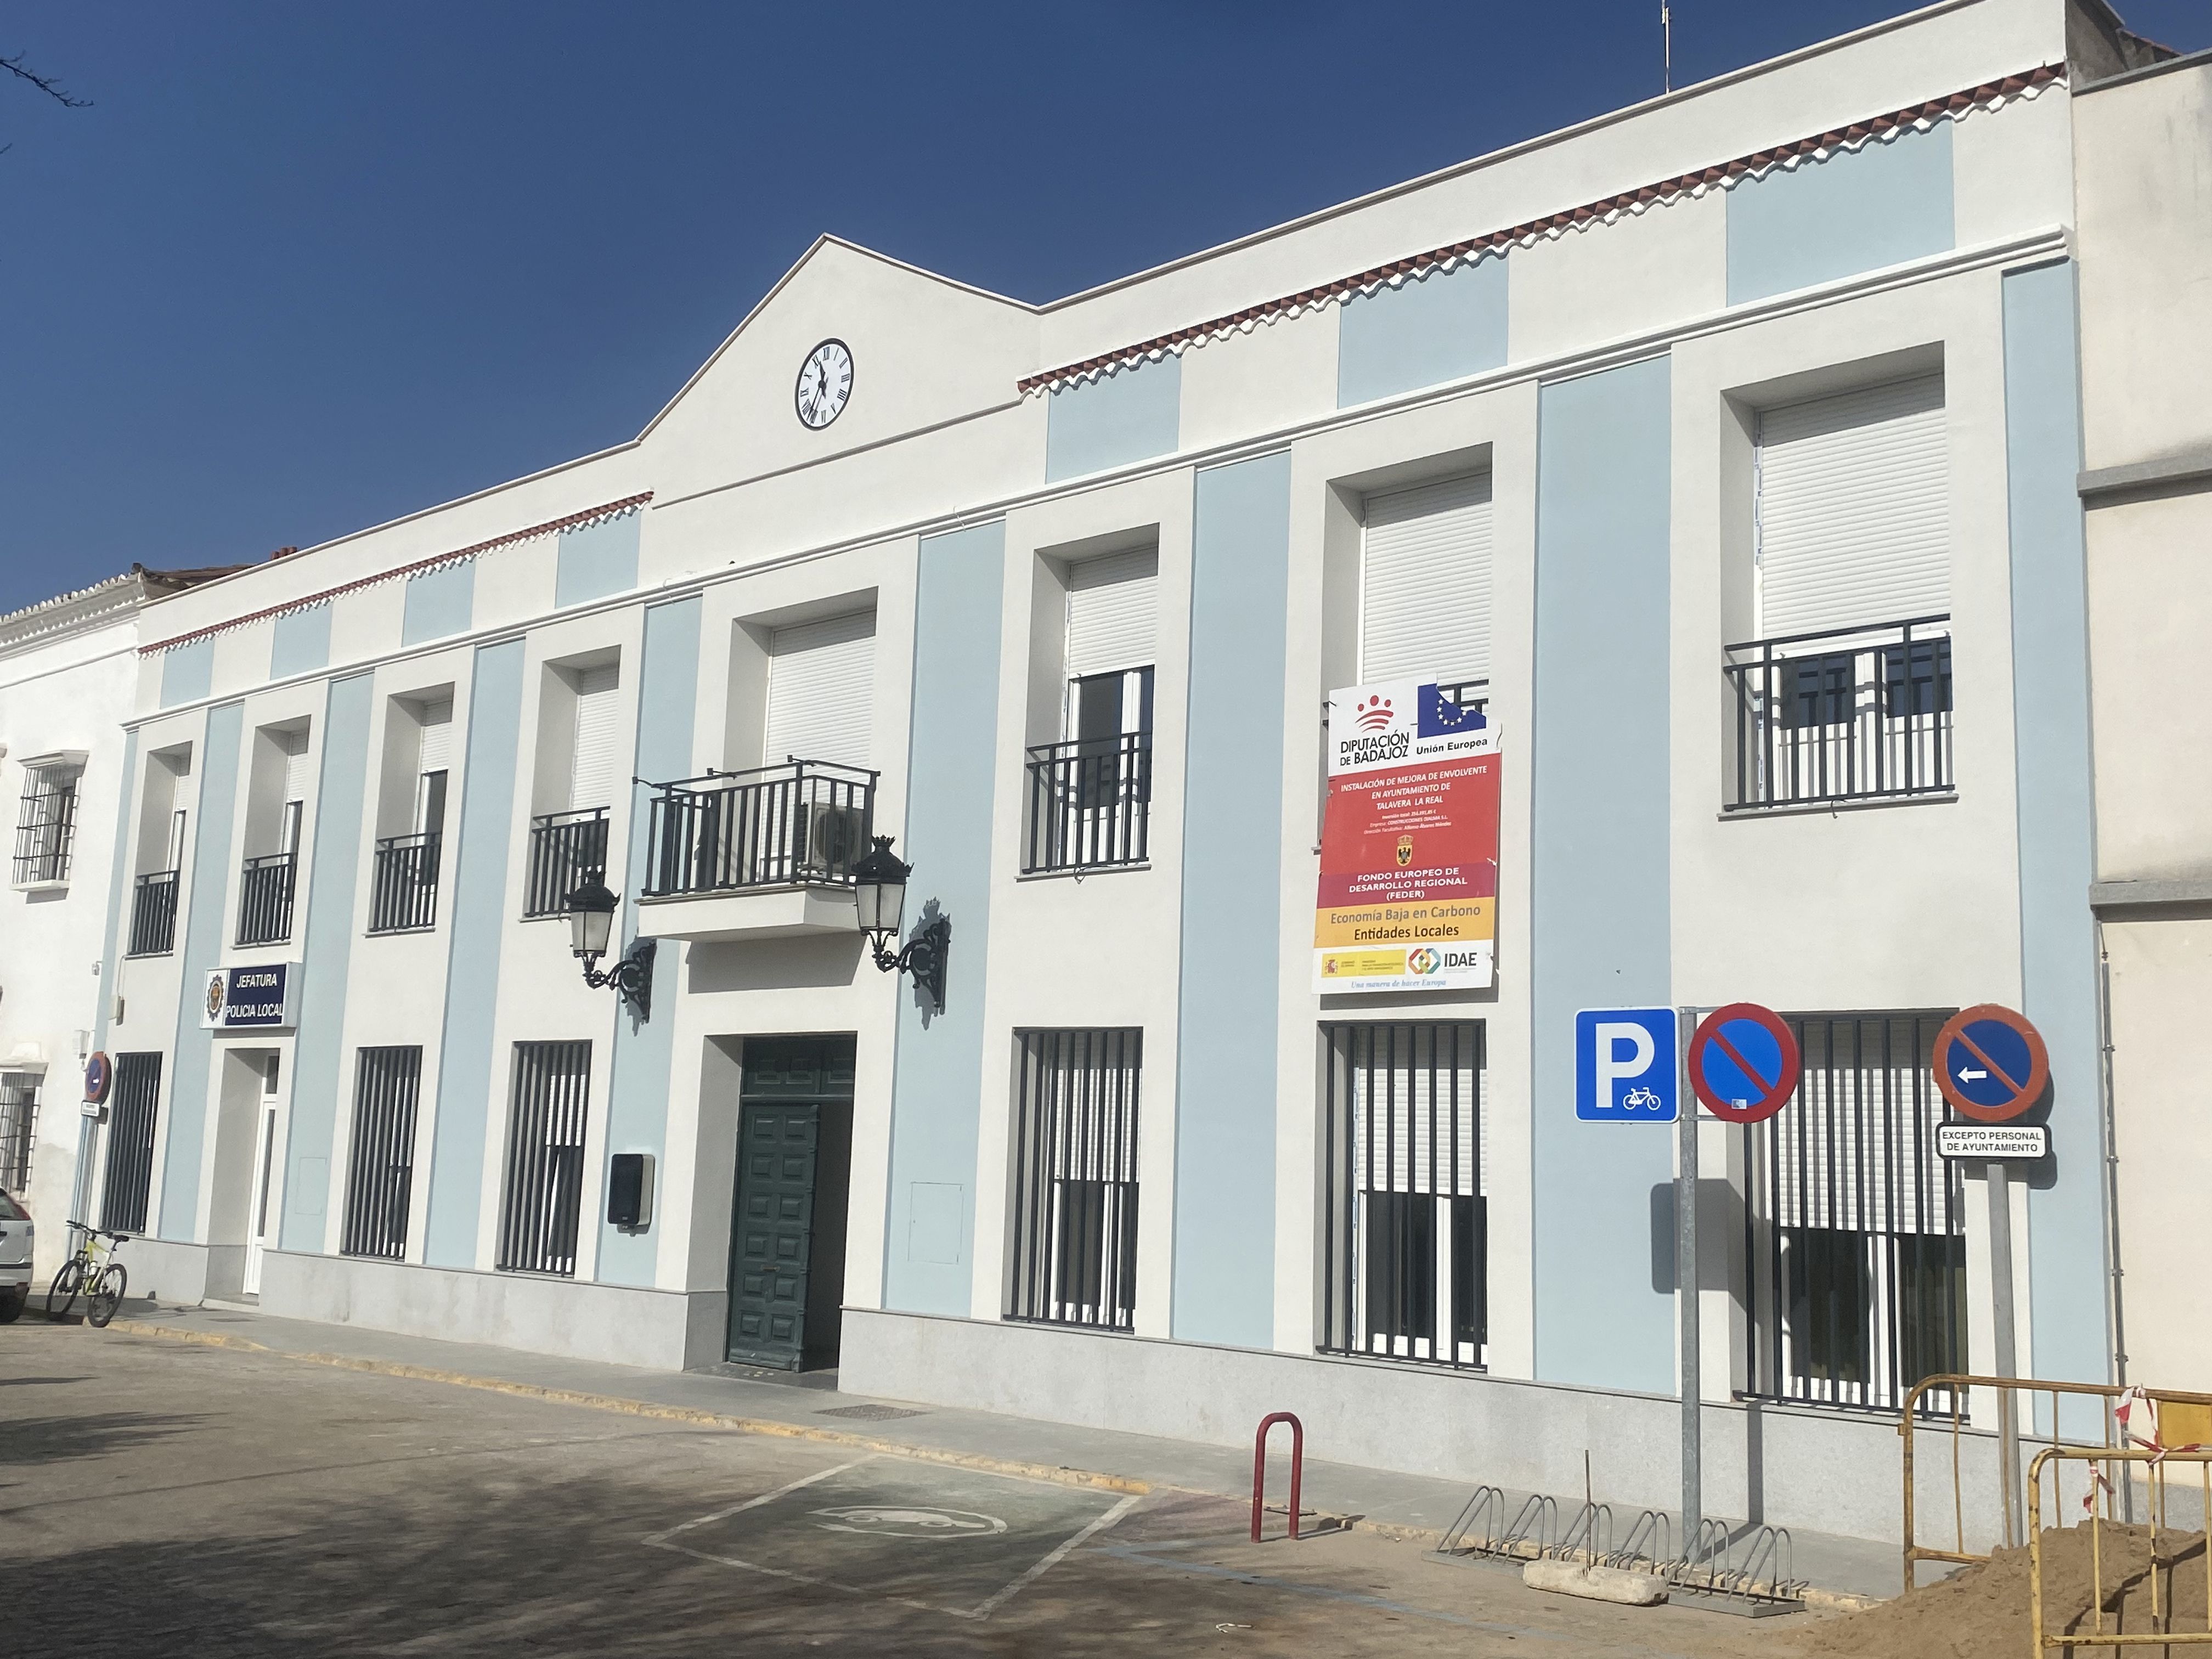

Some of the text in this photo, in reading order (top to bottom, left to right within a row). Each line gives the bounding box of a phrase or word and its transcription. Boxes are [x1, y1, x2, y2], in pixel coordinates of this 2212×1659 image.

[1341, 729, 1409, 753] DIPUTACIÓN
[1417, 738, 1487, 755] Unión Europea
[1340, 745, 1409, 766] DE BADAJOZ
[1341, 766, 1487, 792] INSTALACIÓN DE MEJORA DE ENVOLVENTE
[1372, 782, 1451, 799] EN AYUNTAMIENTO DE
[1376, 795, 1443, 810] TALAVERA LA REAL
[1357, 872, 1392, 882] FONDO
[1394, 868, 1442, 879] EUROPEO
[1348, 877, 1468, 893] DESARROLLO REGIONAL
[1386, 890, 1425, 901] (FEDER)
[1331, 905, 1481, 924] Economía Baja en Carbono
[1354, 923, 1459, 940] Entidades Locales
[1444, 952, 1477, 967] IDAE
[236, 973, 278, 989] JEFATURA
[1421, 979, 1447, 987] Europa
[226, 1003, 283, 1018] POLICIA LOCAL
[1595, 1022, 1656, 1108] P
[1942, 1131, 2042, 1141] EXCEPTO PERSONAL
[1947, 1143, 2038, 1152] DE AYUNTAMIENTO
